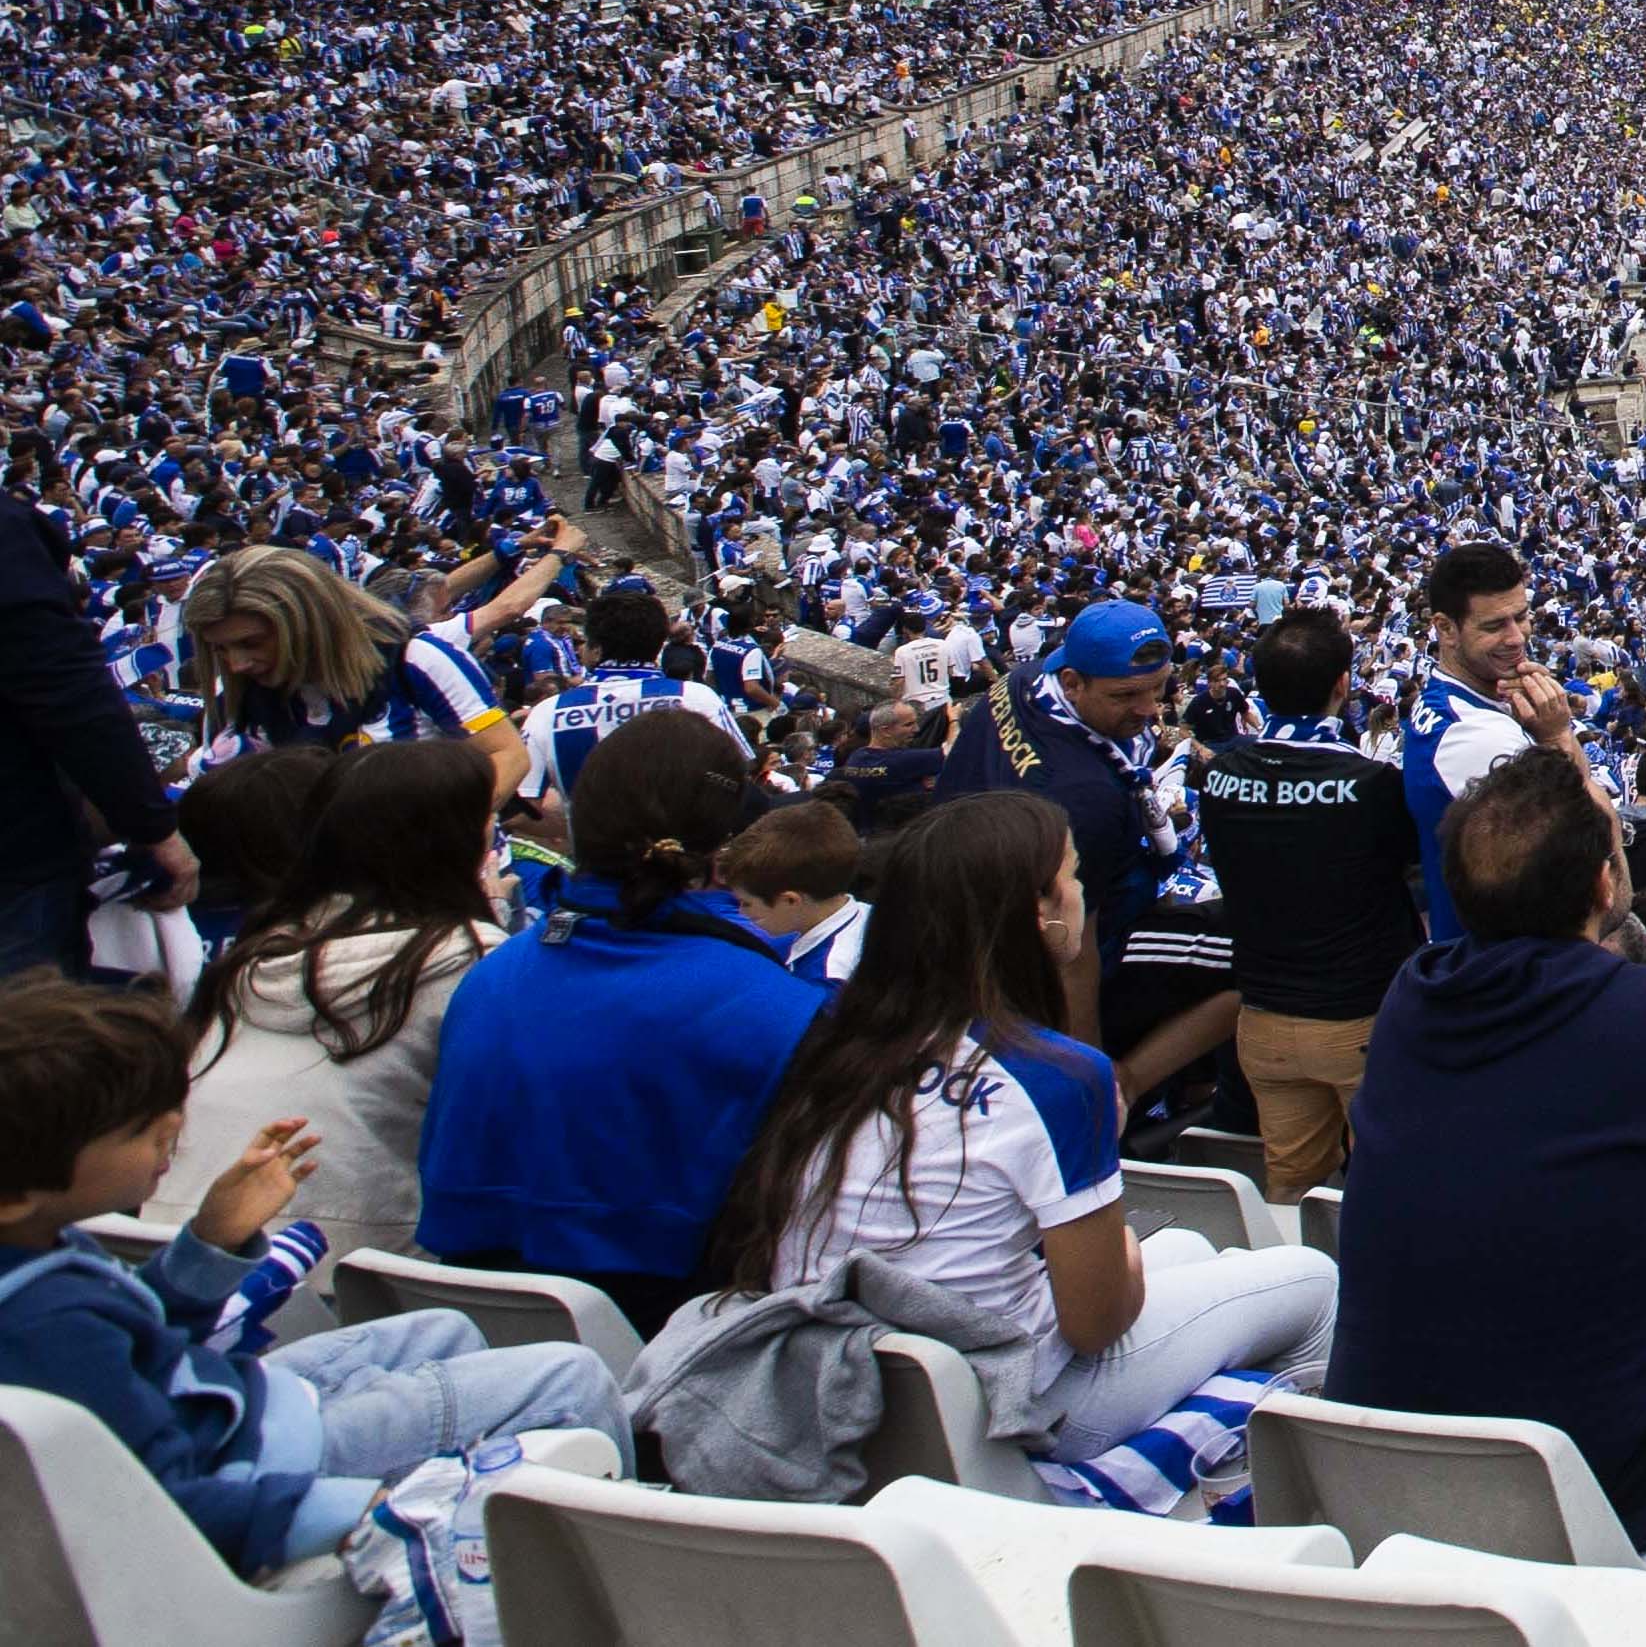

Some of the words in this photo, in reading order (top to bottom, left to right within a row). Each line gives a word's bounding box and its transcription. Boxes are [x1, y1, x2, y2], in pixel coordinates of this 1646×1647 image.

[919, 658, 938, 684] 15
[999, 717, 1042, 779] BOCK
[1202, 768, 1270, 805] SUPER
[1277, 778, 1358, 805] BOCK
